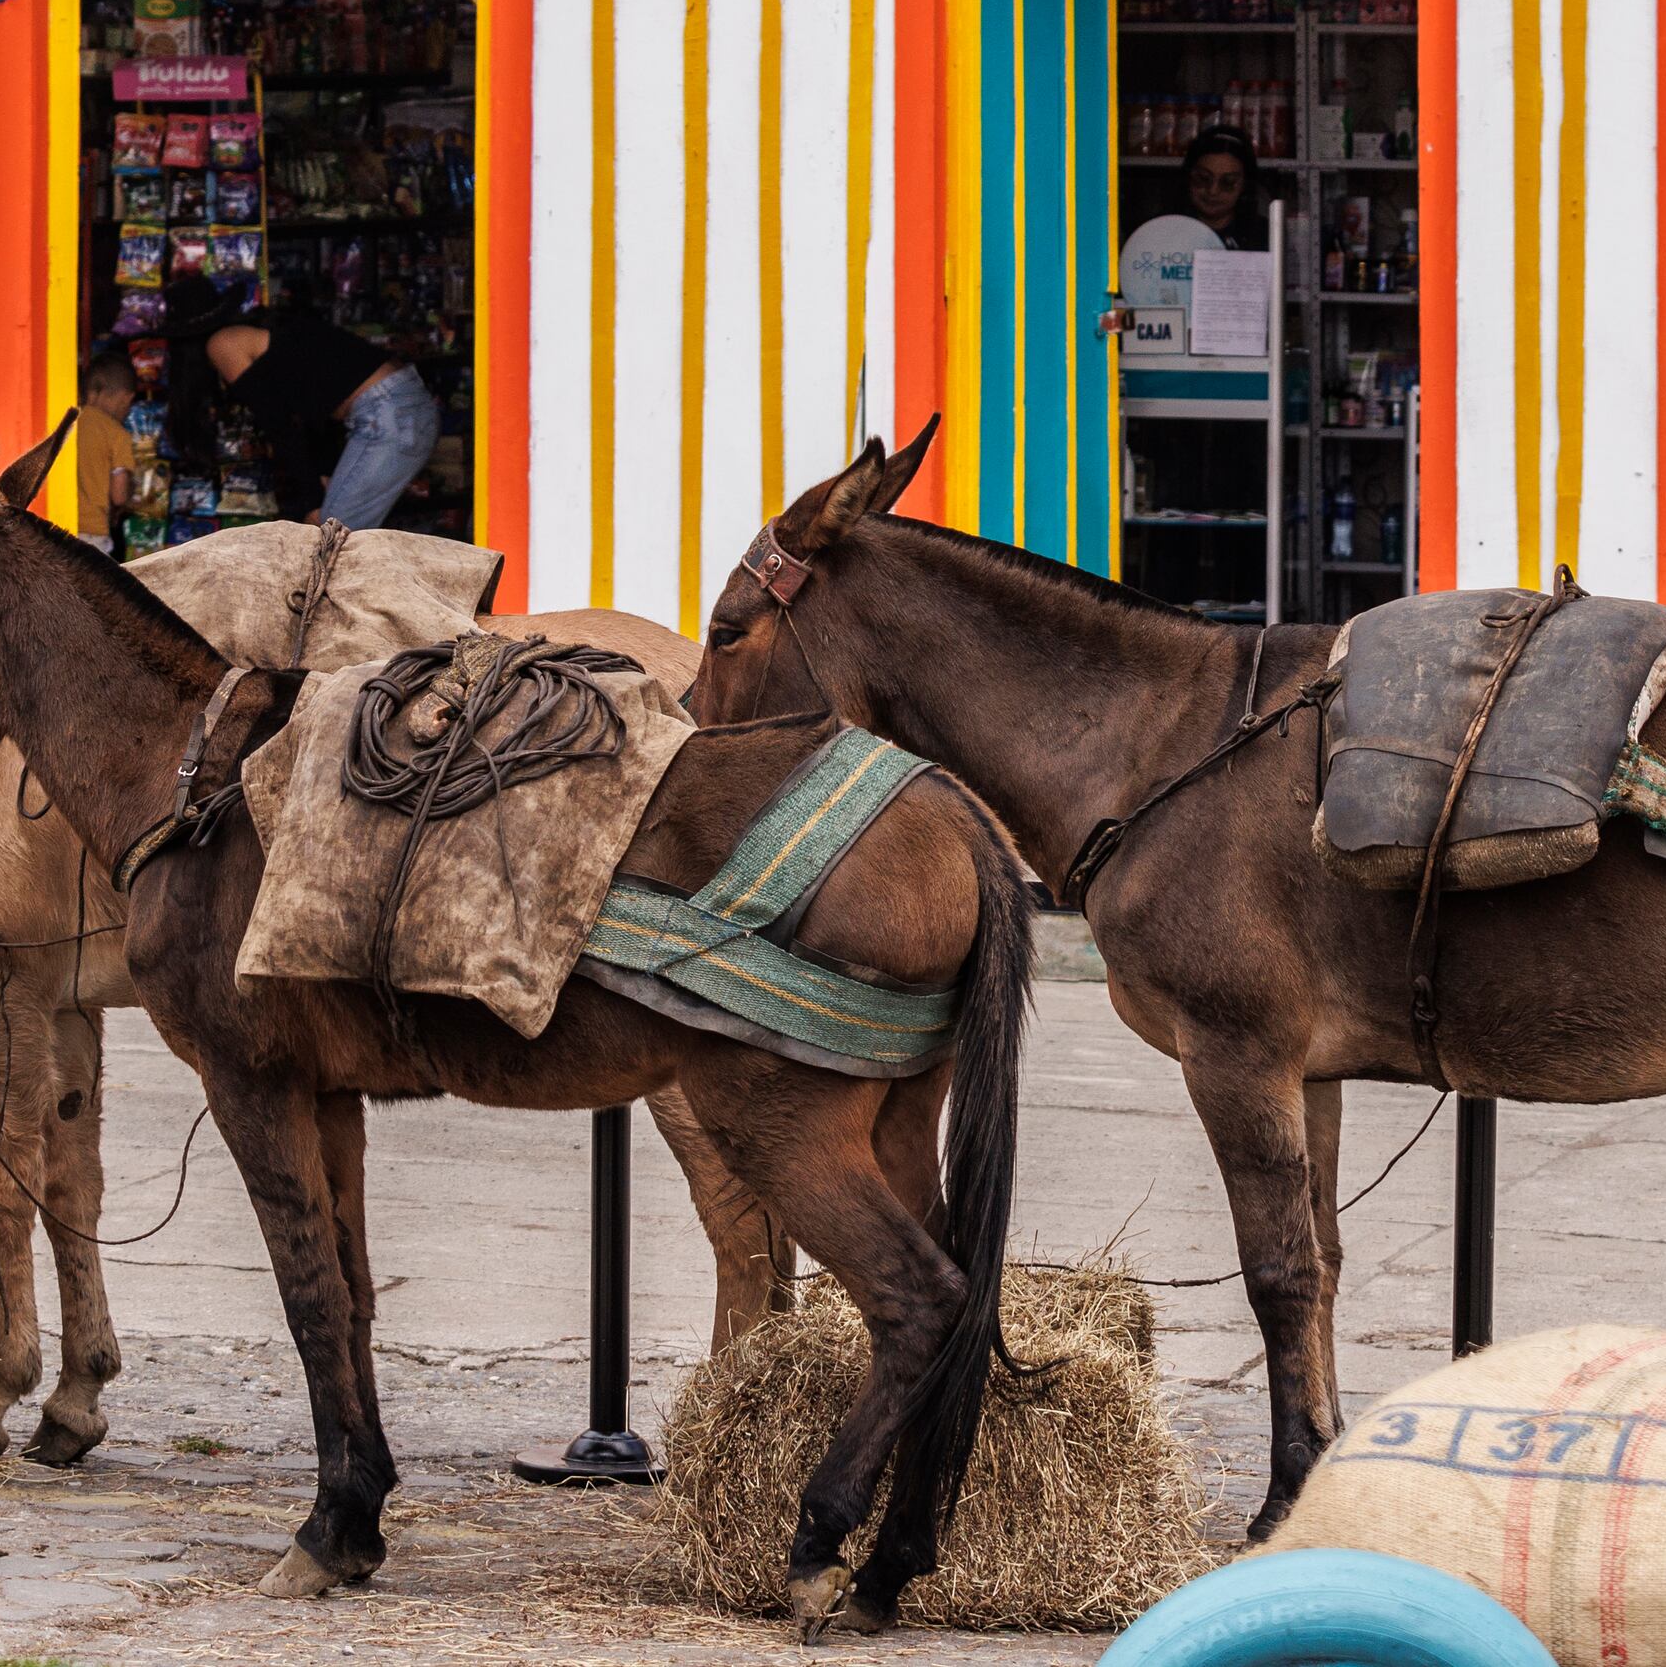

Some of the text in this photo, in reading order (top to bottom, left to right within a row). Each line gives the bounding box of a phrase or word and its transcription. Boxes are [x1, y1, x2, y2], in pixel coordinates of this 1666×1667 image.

[1160, 251, 1195, 264] HOU
[1137, 323, 1172, 341] CAJA
[1369, 1410, 1595, 1465] 3 37
